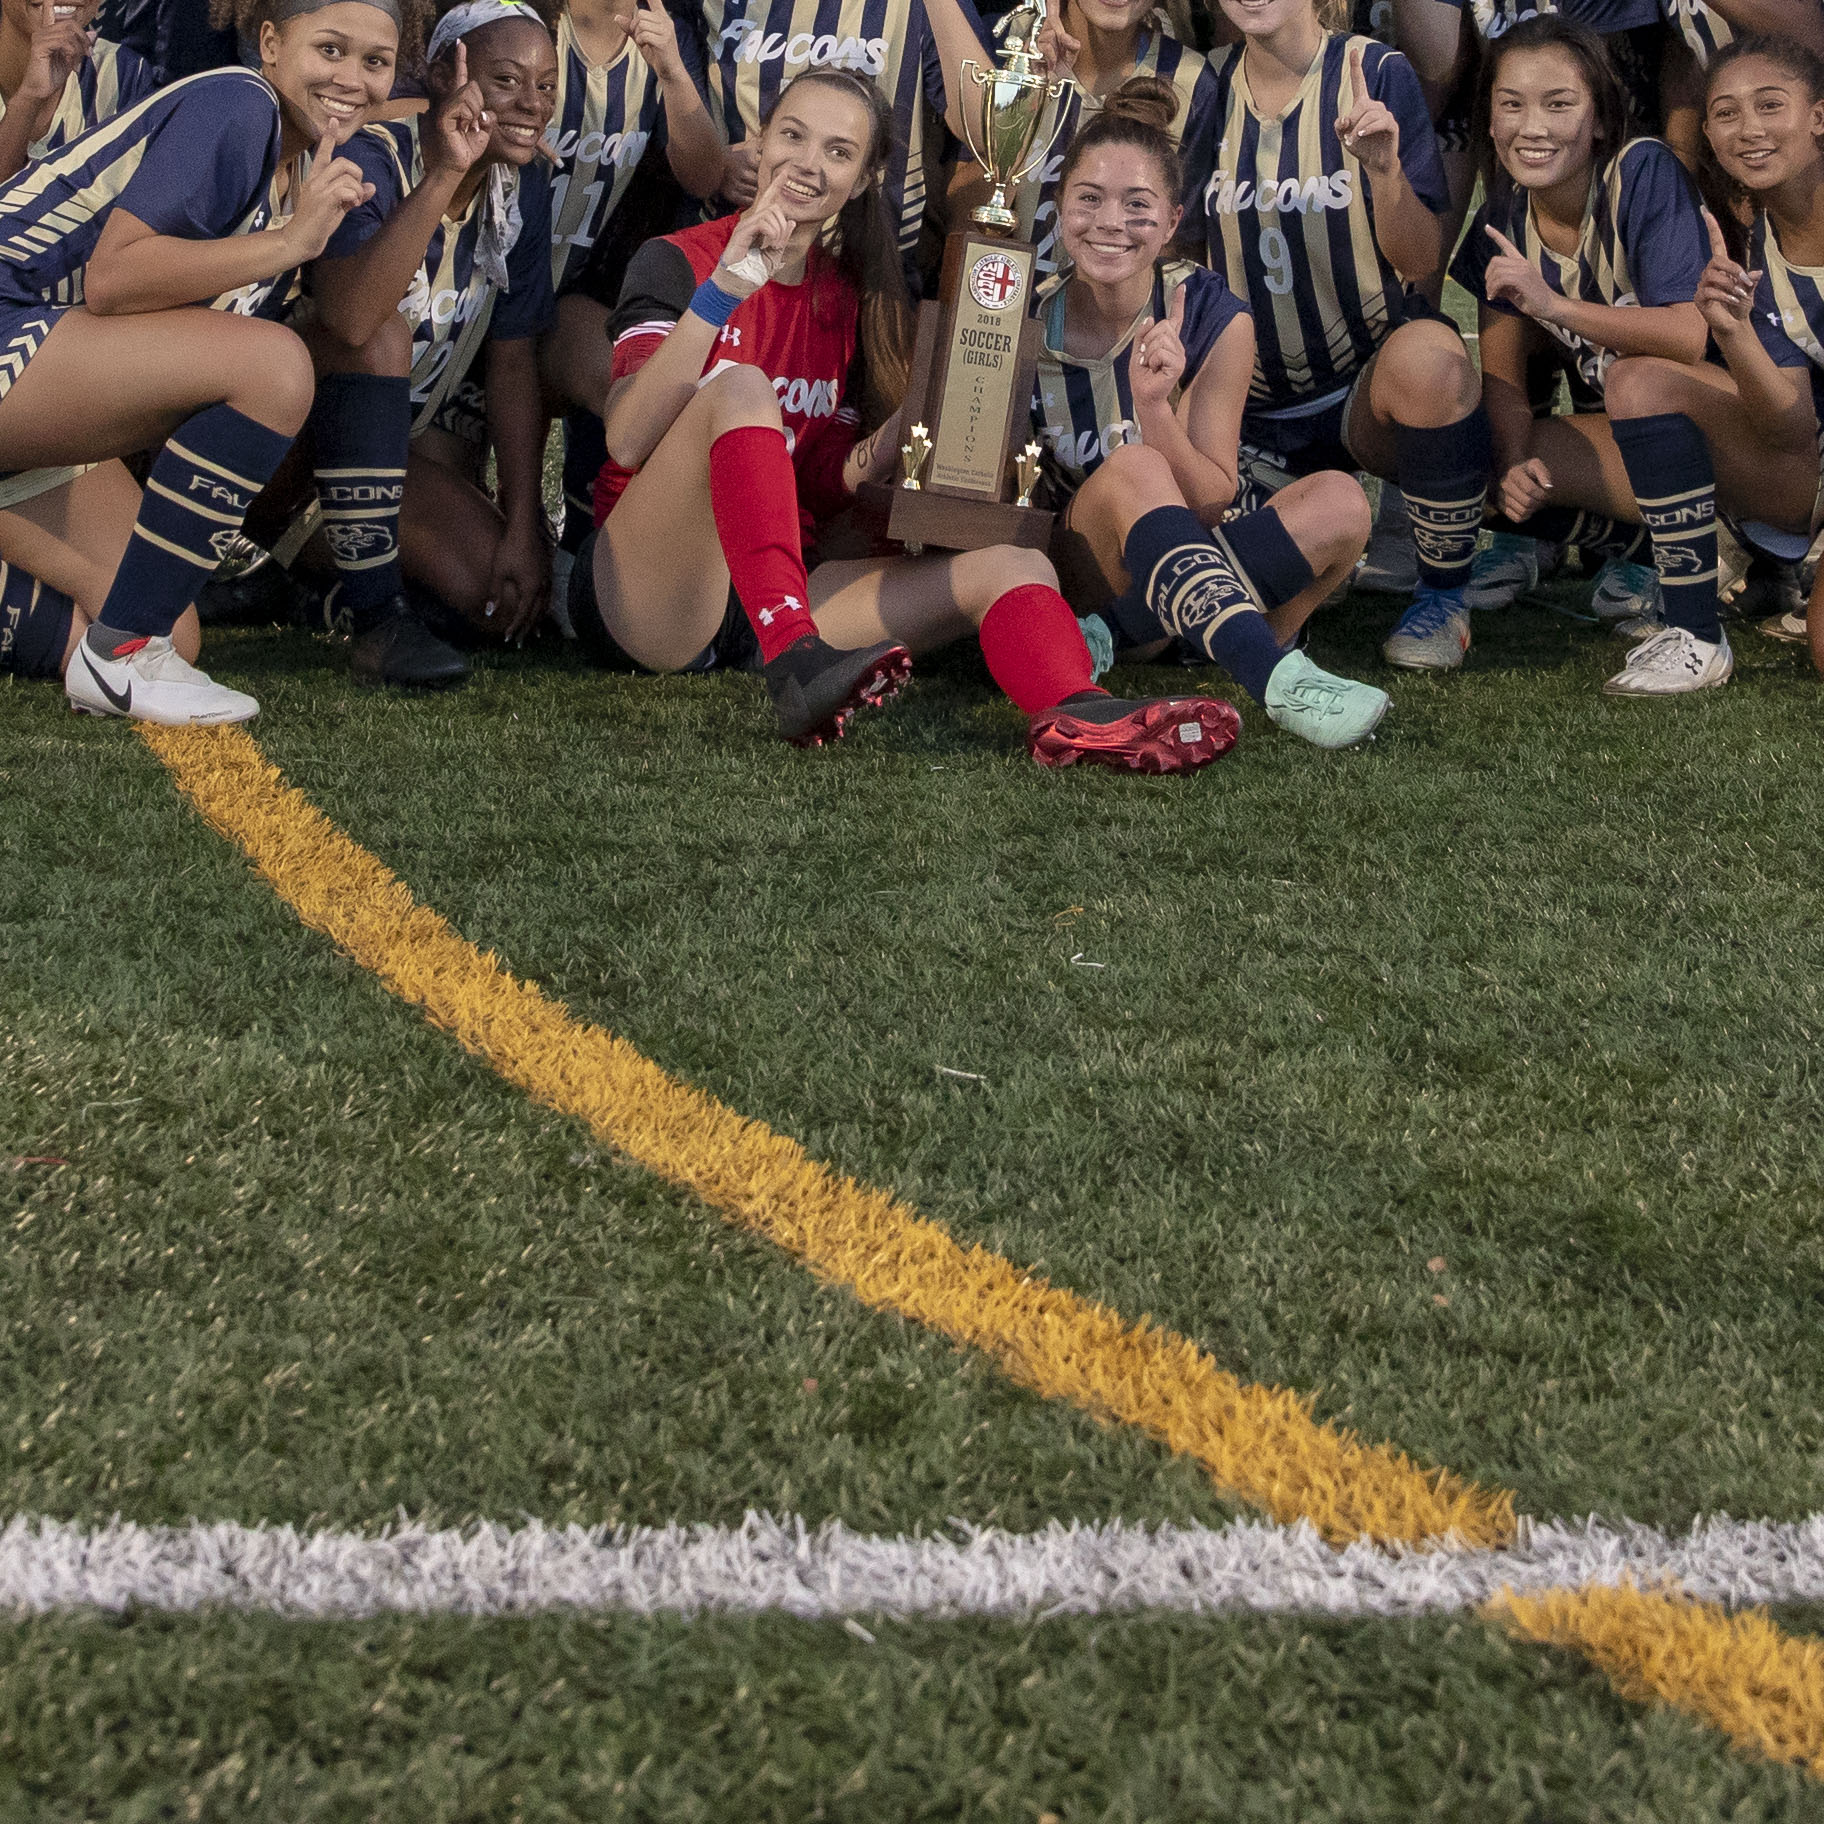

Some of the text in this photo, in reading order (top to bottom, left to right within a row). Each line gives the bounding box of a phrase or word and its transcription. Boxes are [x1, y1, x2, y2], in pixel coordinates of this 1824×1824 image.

[712, 18, 889, 76] FALCONS
[550, 173, 595, 248] 11
[1204, 169, 1353, 217] FALCONS
[1258, 227, 1294, 295] 9
[959, 328, 1012, 353] SOCCER
[977, 314, 1001, 326] 2018
[962, 348, 1003, 370] (GIRLS)
[963, 376, 986, 463] CHAMPIONS
